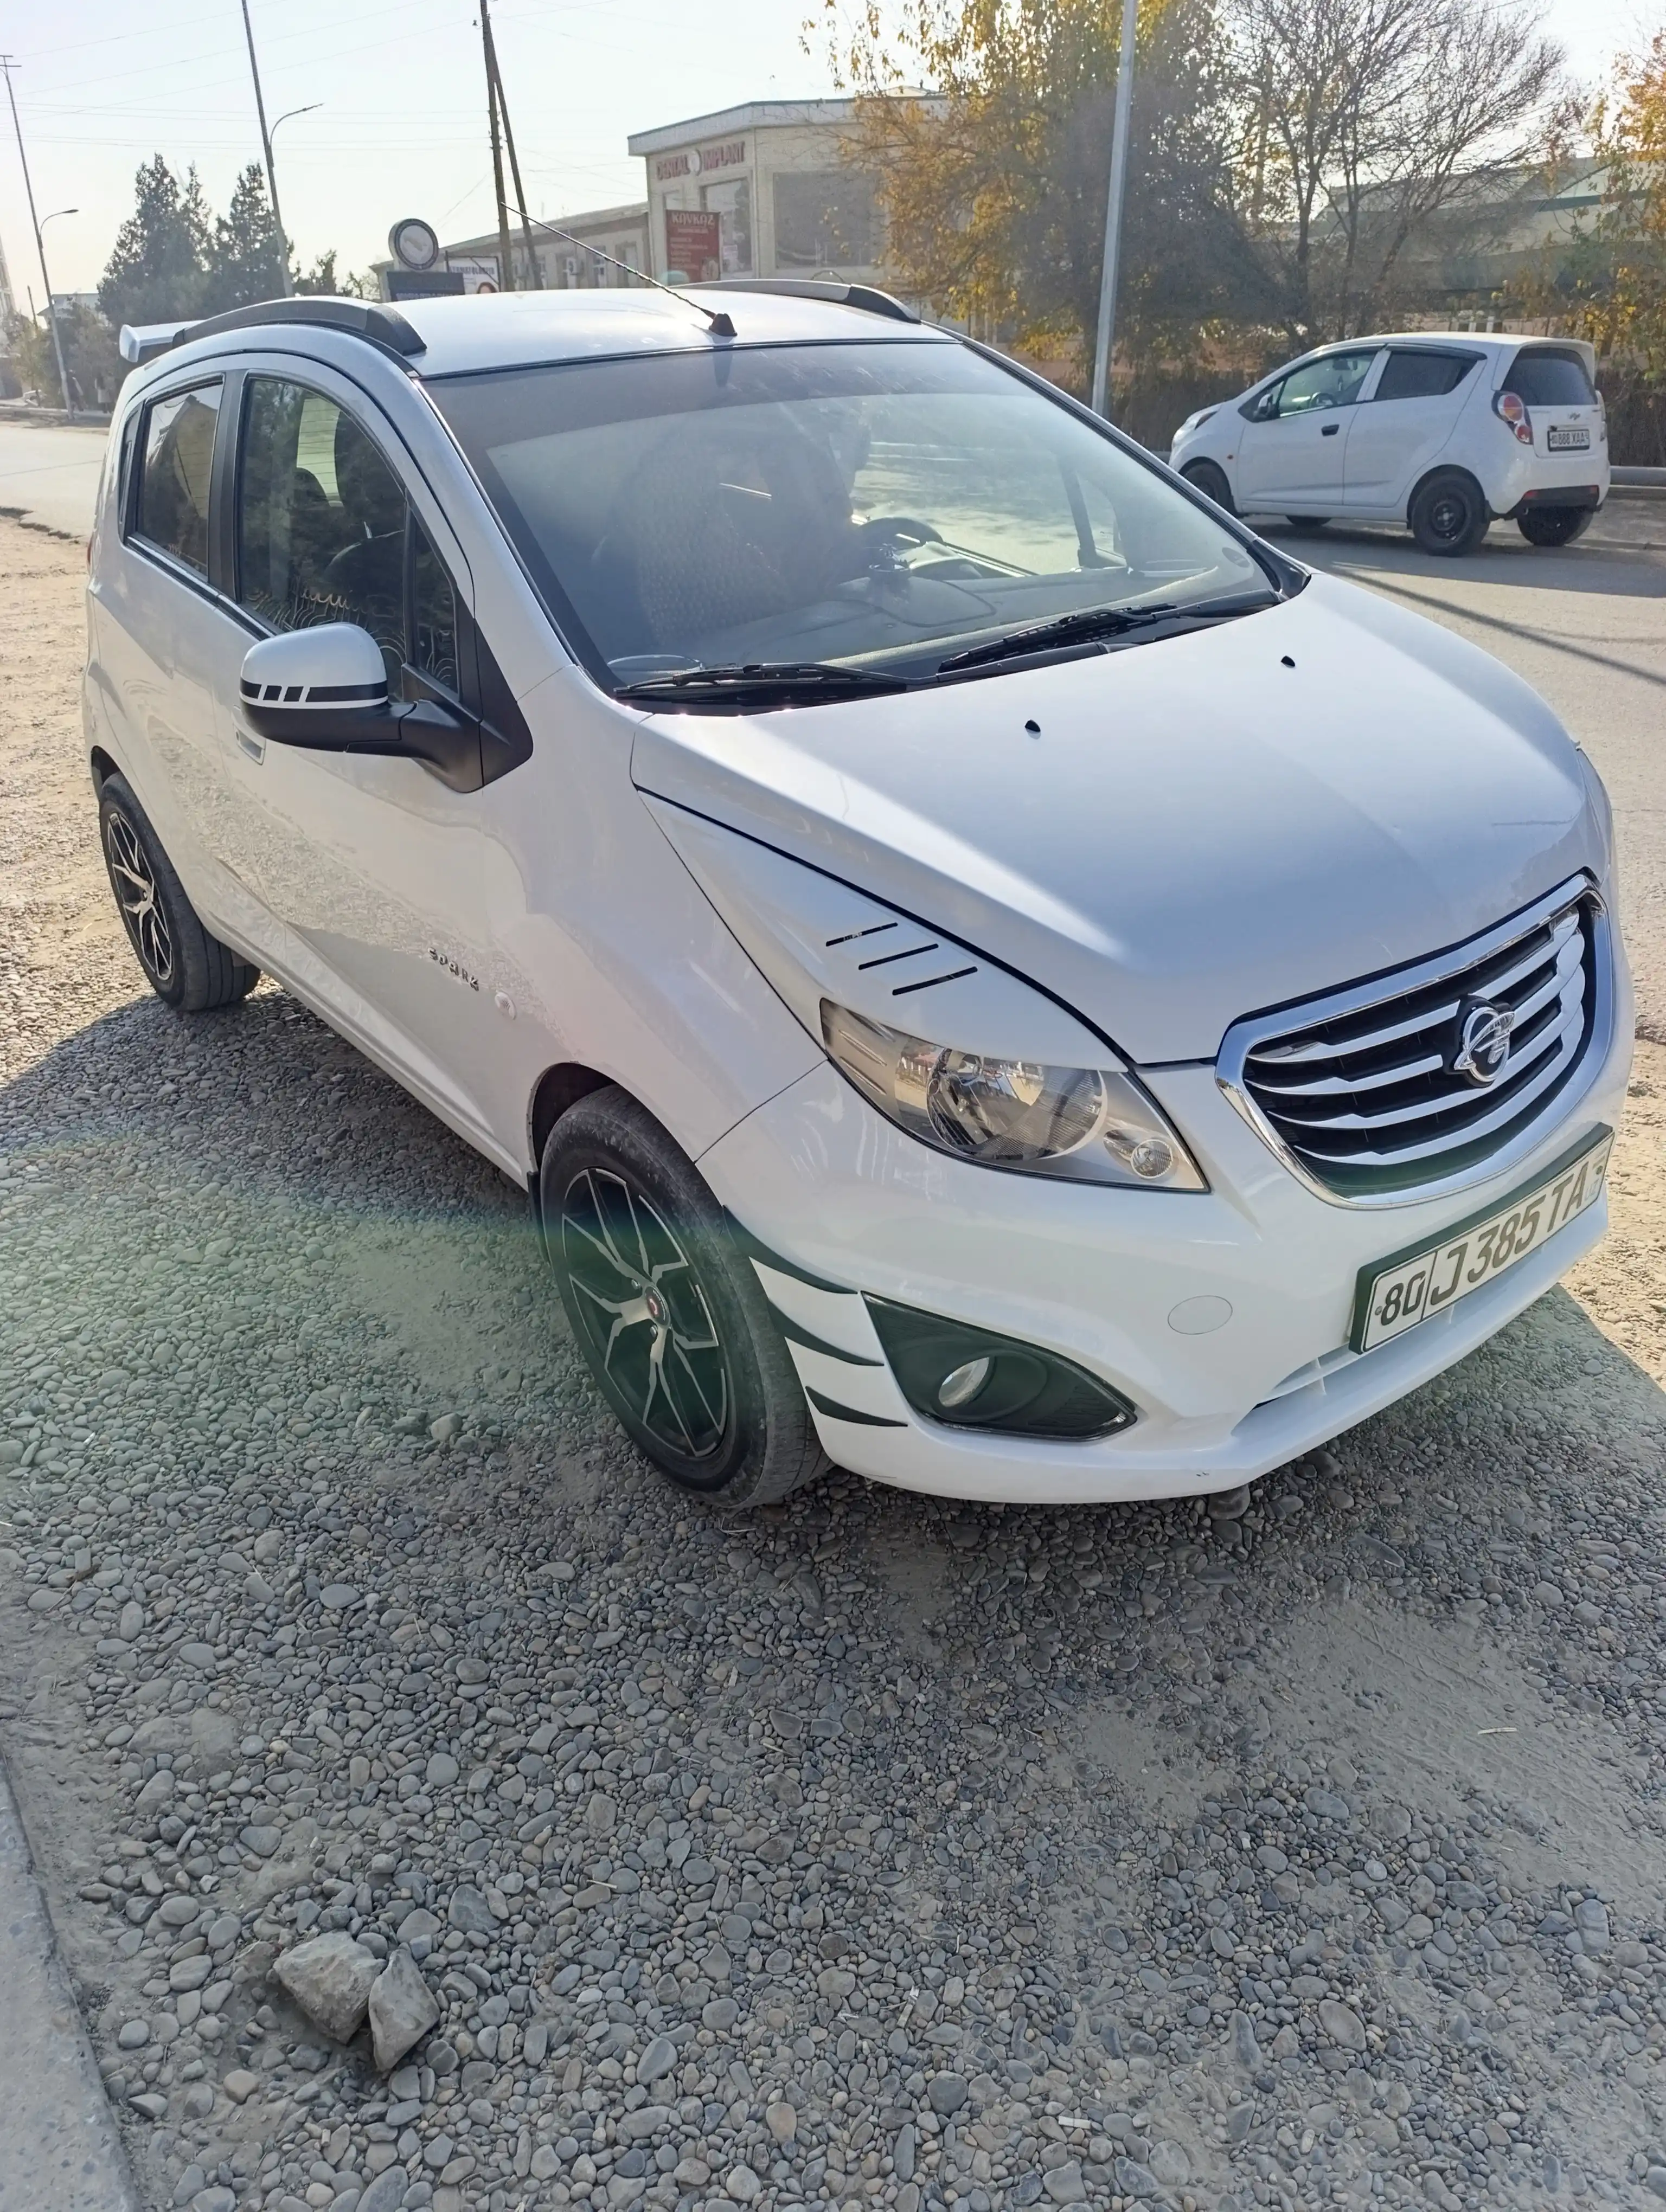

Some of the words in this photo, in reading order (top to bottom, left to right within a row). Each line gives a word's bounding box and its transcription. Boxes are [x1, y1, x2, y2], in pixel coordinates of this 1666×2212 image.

[656, 154, 690, 180] DENTAL
[703, 141, 745, 171] IMPLANT
[1380, 1270, 1426, 1326] 80
[1430, 1243, 1469, 1306] J
[1468, 1194, 1546, 1283] 385
[1547, 1161, 1589, 1233] TA
